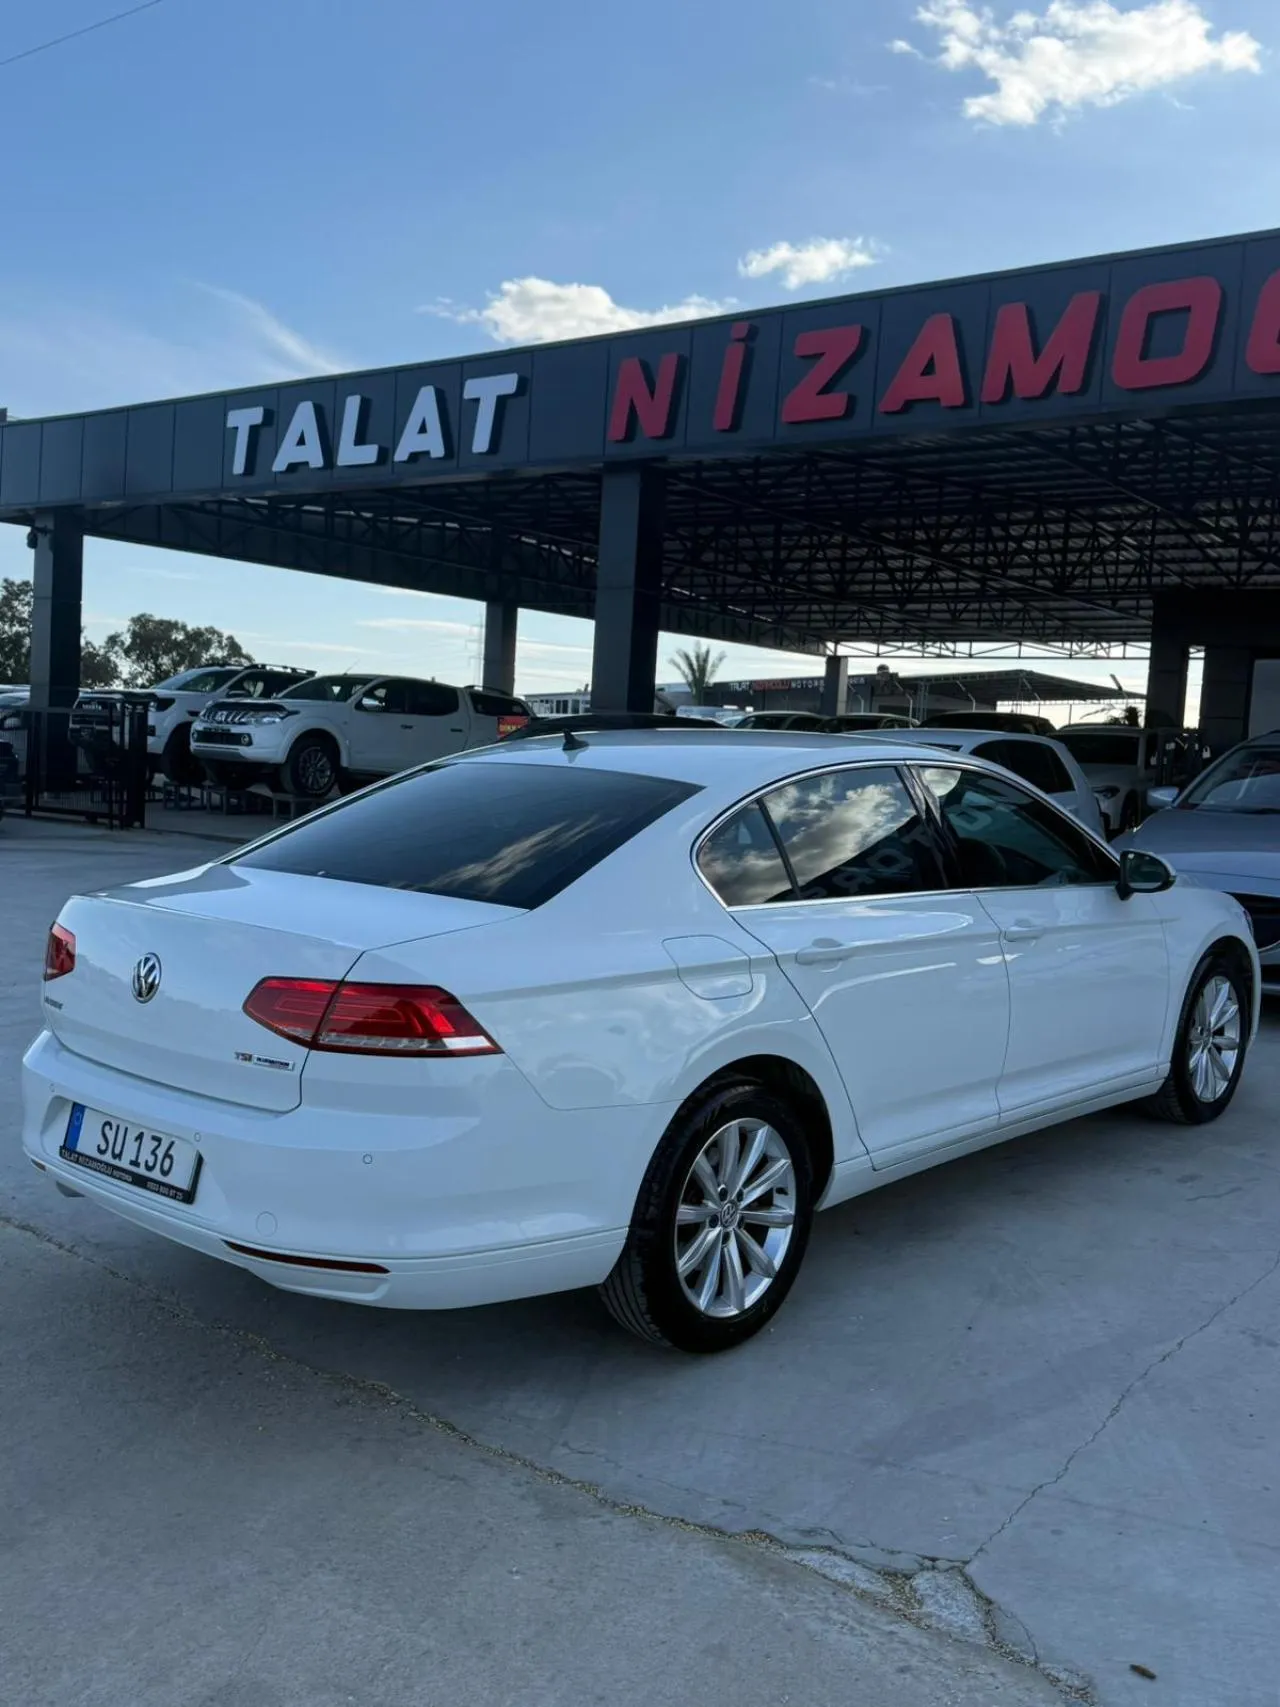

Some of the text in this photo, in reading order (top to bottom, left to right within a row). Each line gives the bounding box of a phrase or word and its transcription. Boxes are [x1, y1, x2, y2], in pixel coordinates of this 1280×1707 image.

[227, 373, 518, 475] TALAT
[97, 1120, 176, 1177] SU 136
